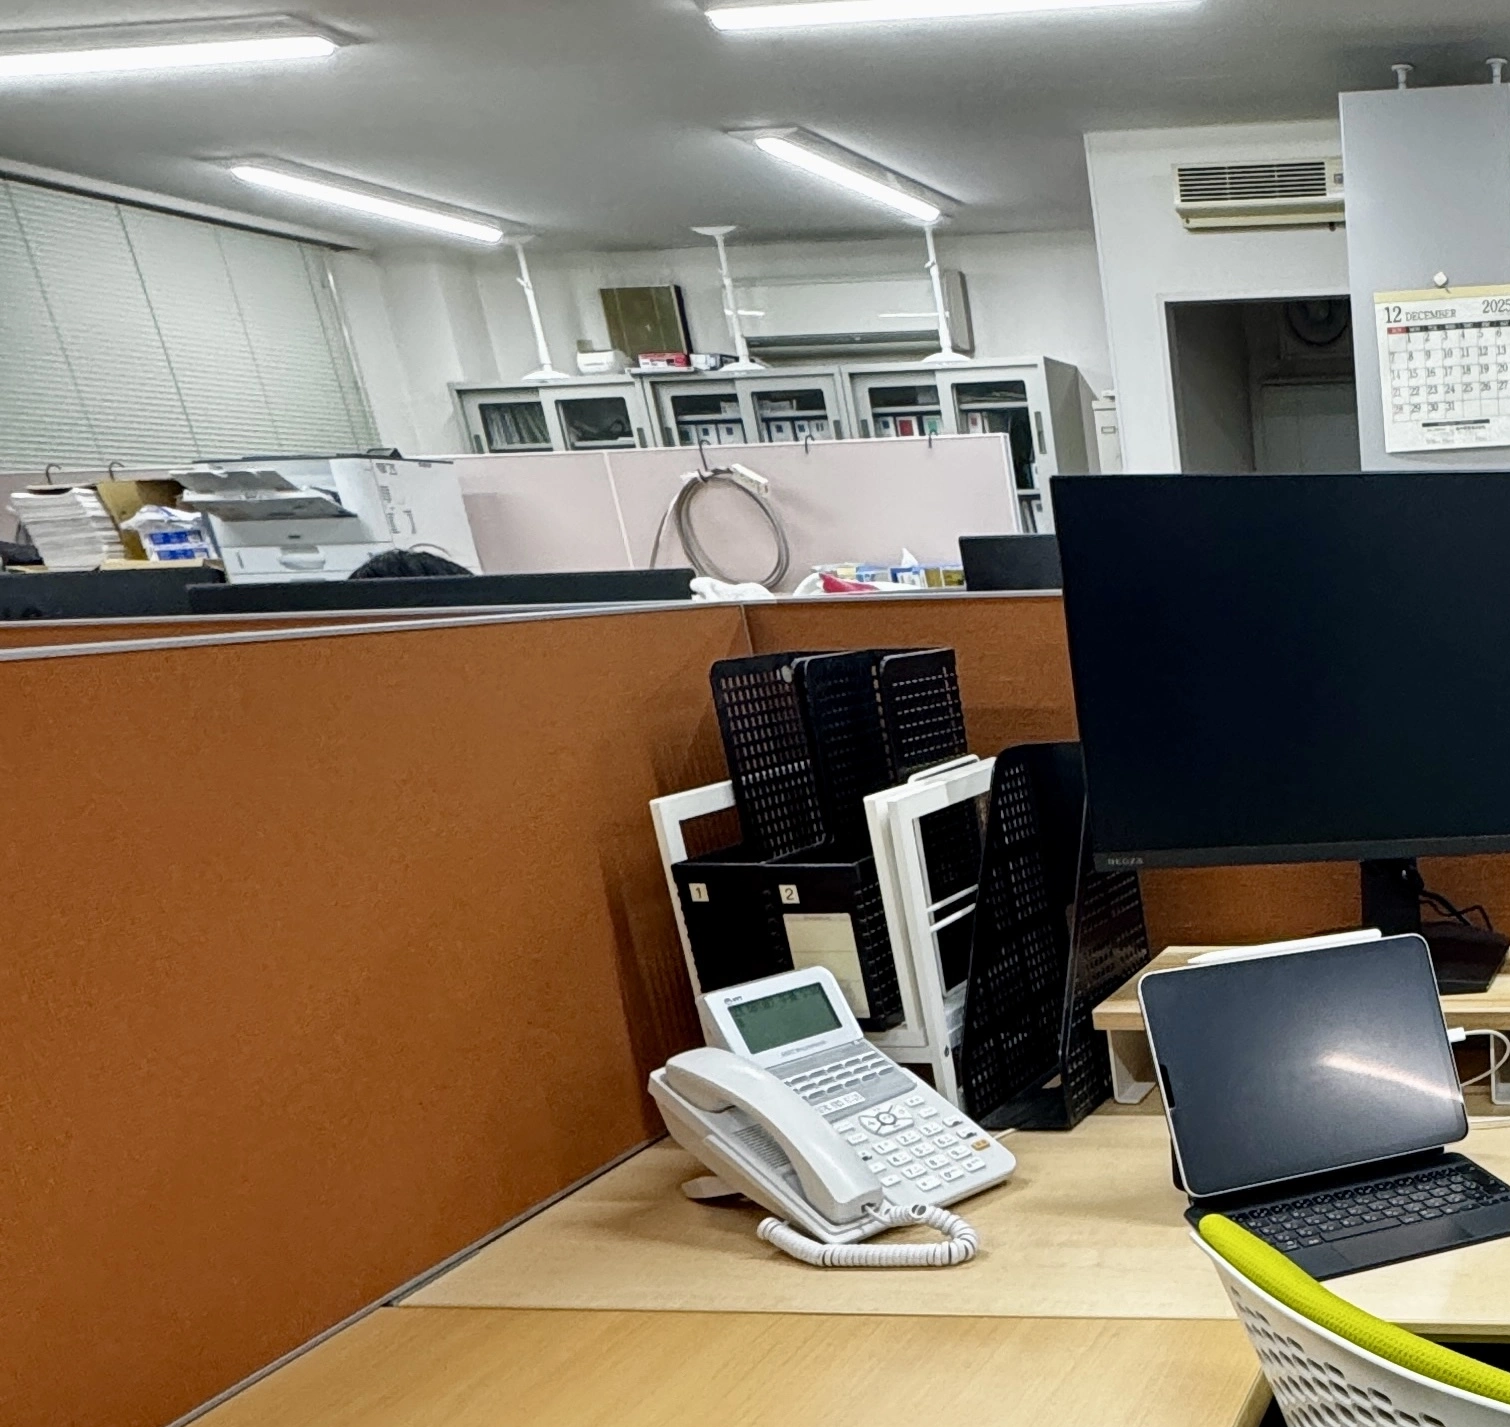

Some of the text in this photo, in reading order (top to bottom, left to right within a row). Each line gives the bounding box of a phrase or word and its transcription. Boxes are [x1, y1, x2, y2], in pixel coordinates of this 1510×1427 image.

[1385, 306, 1402, 323] 12
[1405, 309, 1456, 321] DECEMBER
[1390, 345, 1506, 362] 7 8 9 10 11 12 13
[1409, 369, 1418, 378] 15
[1427, 367, 1436, 377] 16
[1444, 366, 1453, 376] 17
[1462, 365, 1471, 375] 18
[1480, 364, 1489, 374] 19
[1498, 363, 1508, 373] 20
[1410, 386, 1420, 396] 22
[1428, 385, 1438, 395] 23
[1445, 384, 1455, 394] 24
[1463, 383, 1473, 393] 25
[1481, 382, 1491, 391] 26
[1499, 380, 1508, 390] 27
[1411, 403, 1420, 413] 29
[1428, 402, 1438, 412] 30
[1446, 401, 1455, 411] 31
[695, 887, 795, 900] 1 2
